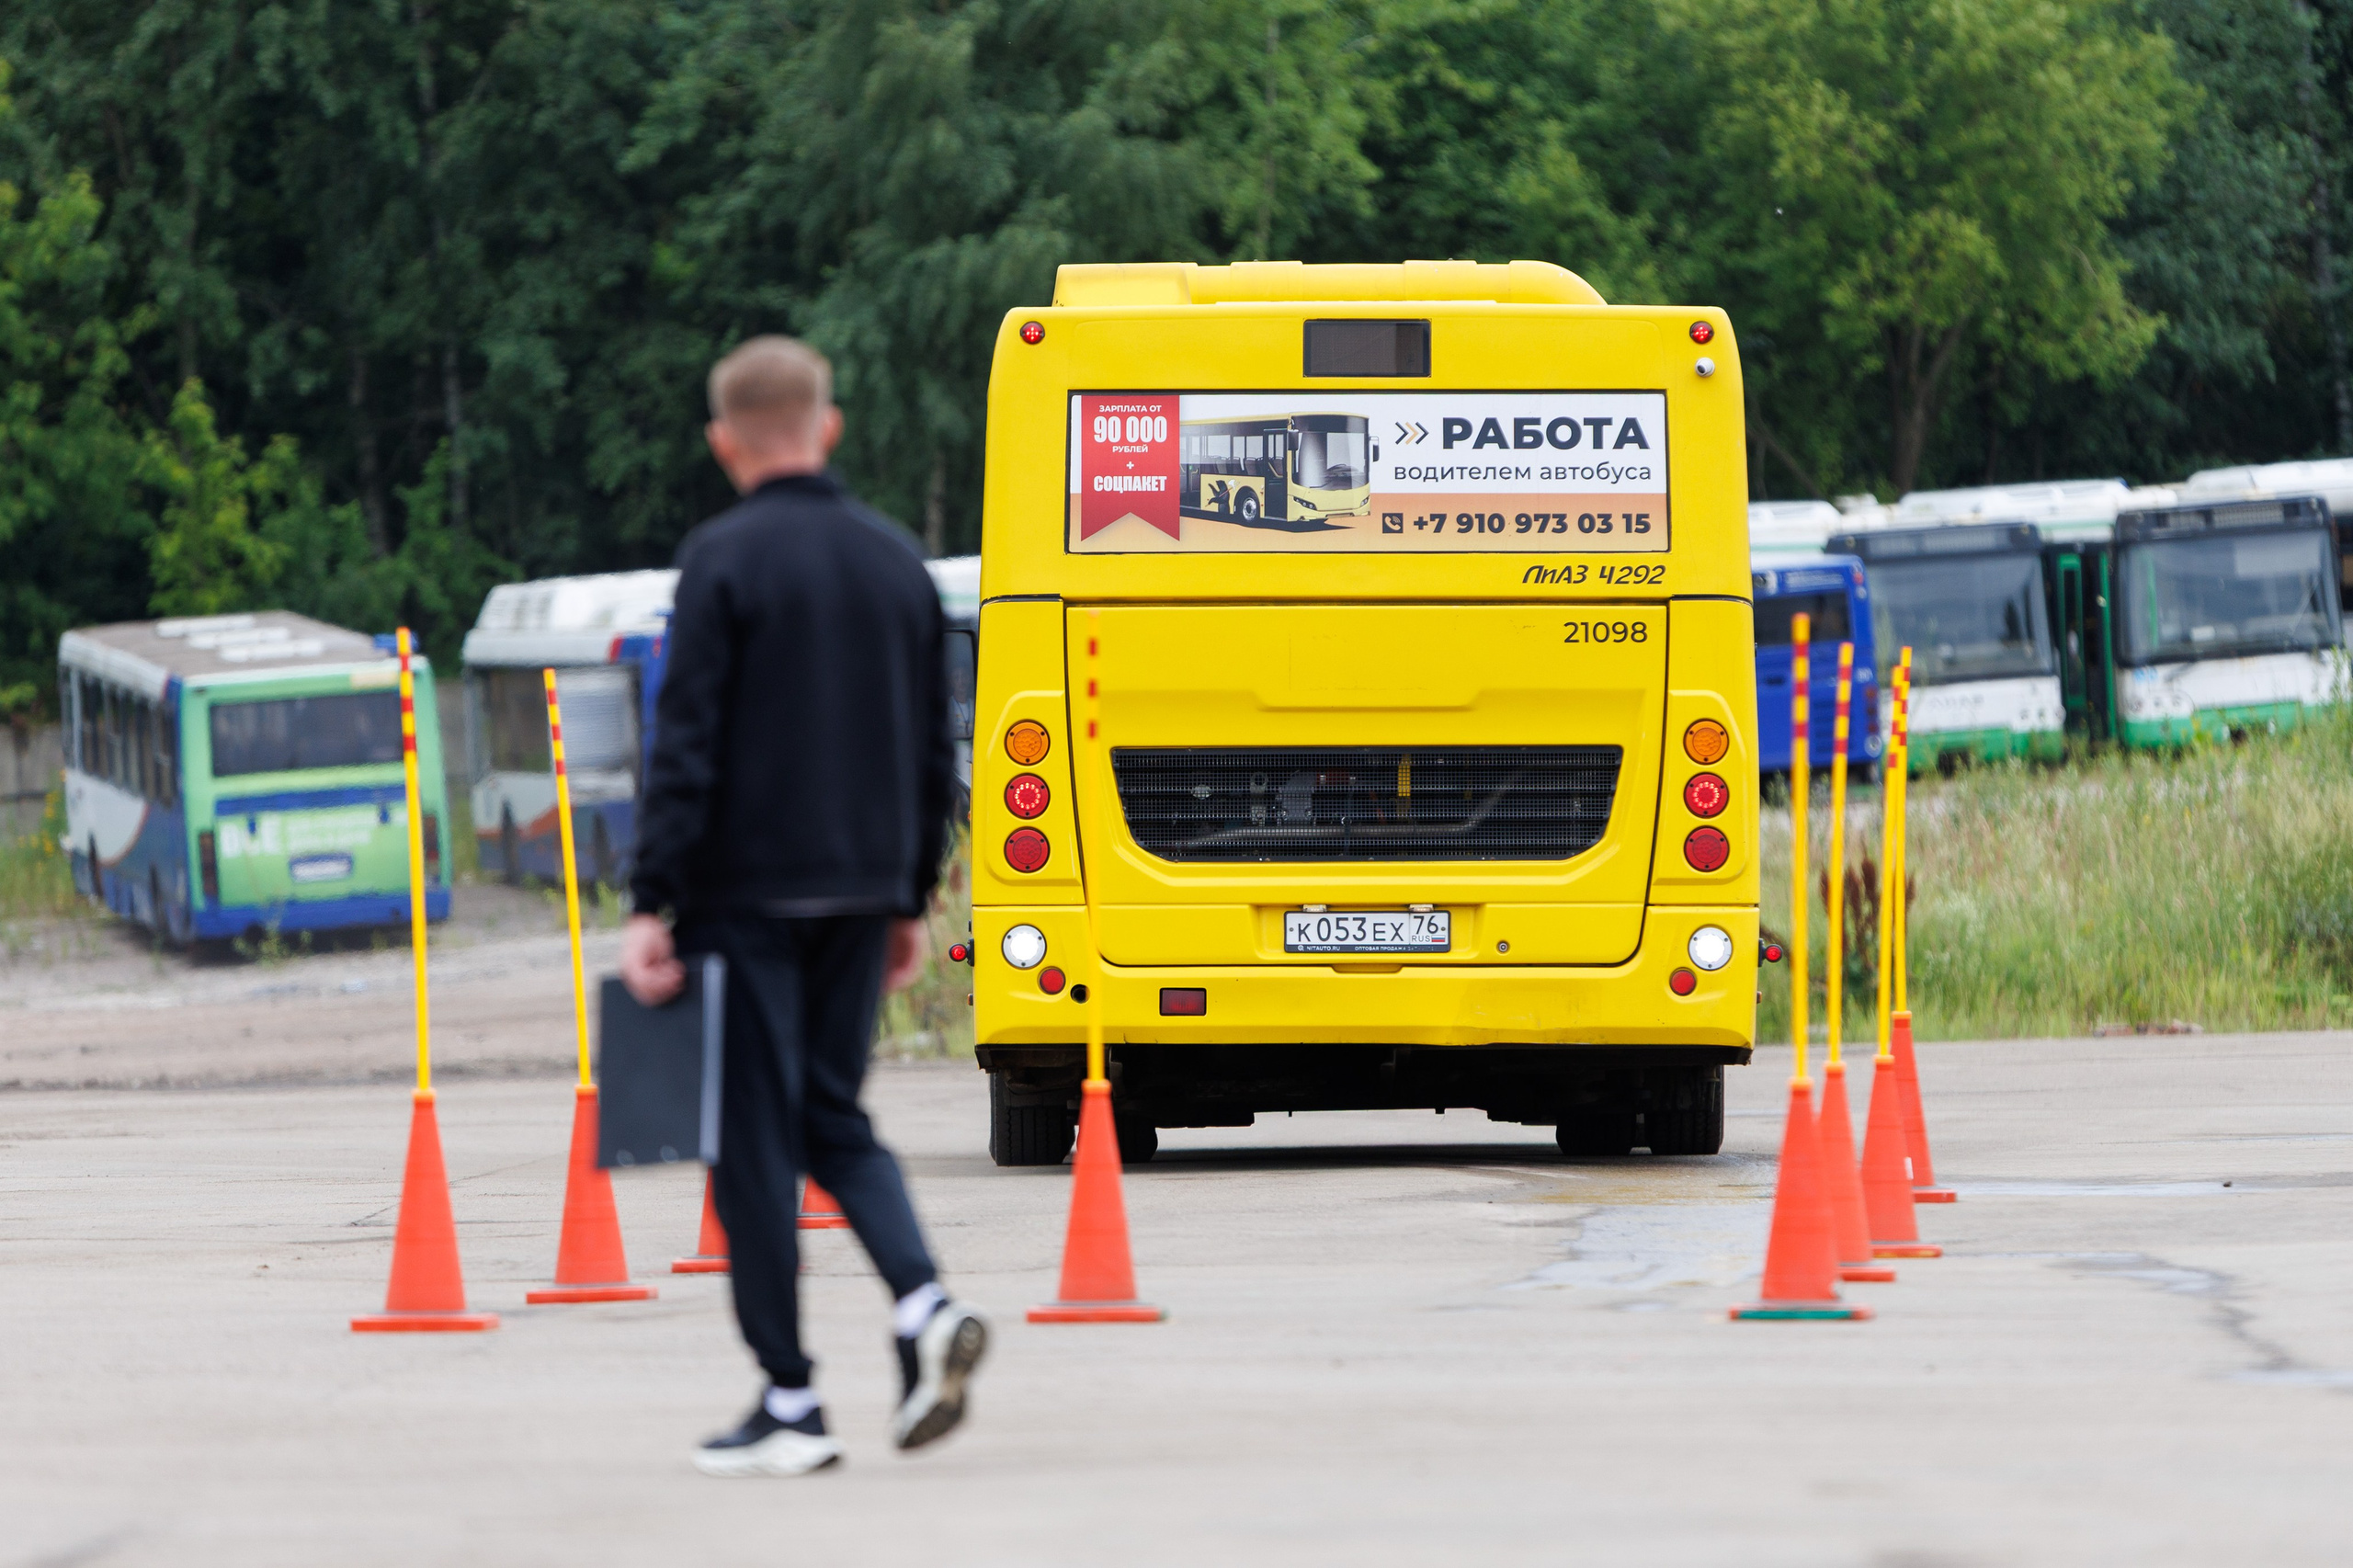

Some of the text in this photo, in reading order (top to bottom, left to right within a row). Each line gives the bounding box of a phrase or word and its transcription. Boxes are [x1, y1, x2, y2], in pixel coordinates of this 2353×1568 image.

[1099, 404, 1162, 413] ЗАРПЛАТА ОТ
[1094, 415, 1167, 443] 90 000
[1442, 416, 1651, 450] РАБОТА
[1112, 444, 1149, 453] РУБЛЕЙ
[1393, 460, 1652, 484] водителем автобуса
[1094, 475, 1167, 494] СОЦПАКЕТ
[1413, 513, 1652, 534] +7 910 973 03 15
[1598, 564, 1666, 585] 4292
[1563, 621, 1648, 643] 21098
[1413, 915, 1438, 935] 76
[1411, 935, 1431, 943] RUS
